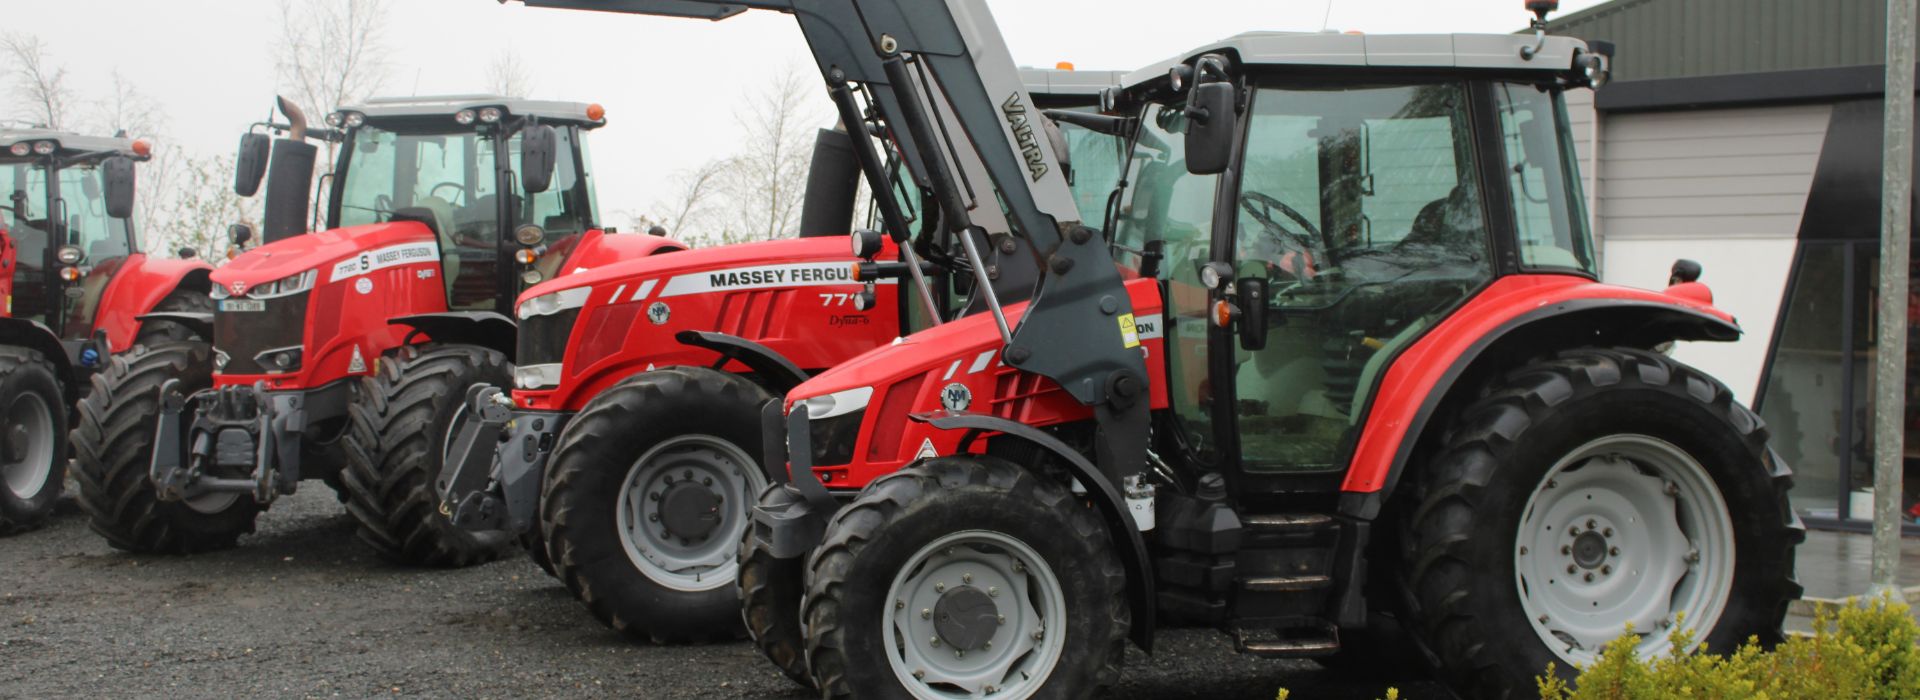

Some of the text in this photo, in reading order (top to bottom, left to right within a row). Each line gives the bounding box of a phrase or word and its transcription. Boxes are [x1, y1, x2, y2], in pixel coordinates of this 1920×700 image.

[1002, 91, 1048, 183] VALTRA
[361, 255, 369, 270] S
[376, 251, 400, 264] MASSEY
[401, 247, 432, 259] FERGUSON
[710, 267, 853, 287] MASSEY FERGU
[1137, 323, 1154, 334] ON
